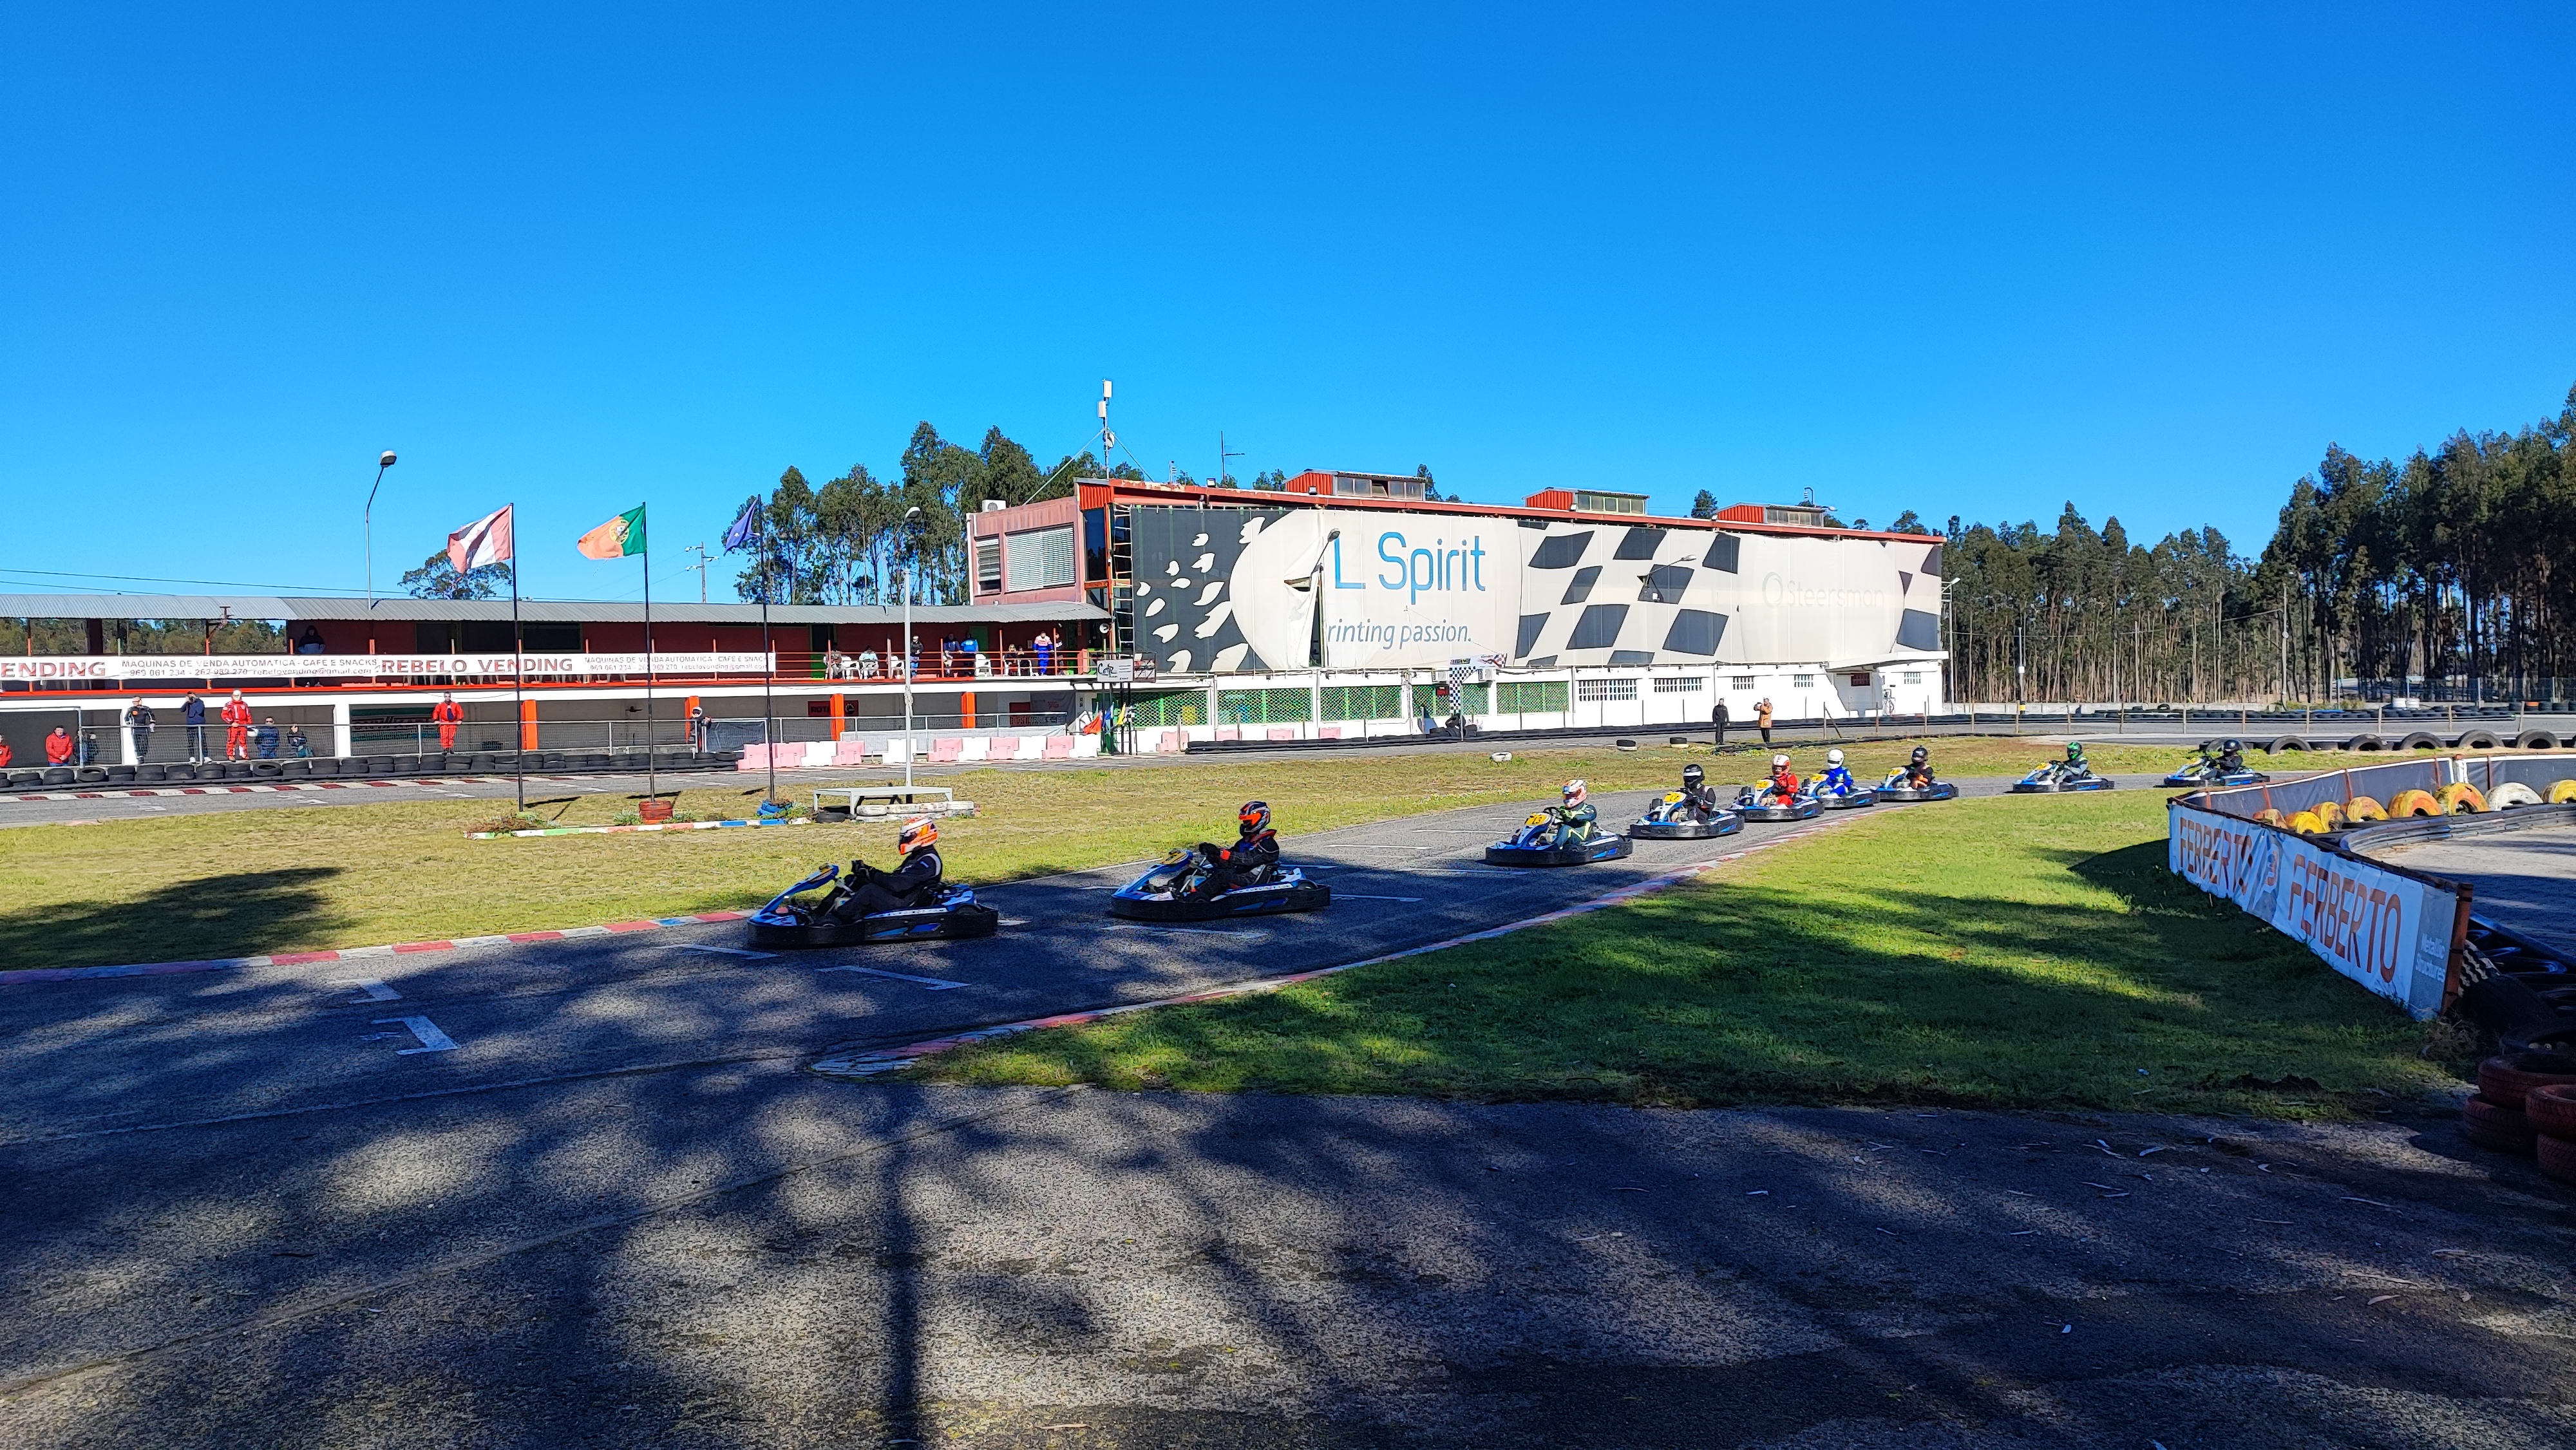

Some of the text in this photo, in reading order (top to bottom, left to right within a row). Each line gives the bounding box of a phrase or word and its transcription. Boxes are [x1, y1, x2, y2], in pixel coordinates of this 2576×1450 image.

[1378, 532, 1486, 605] Spirit
[1399, 619, 1472, 650] passion.
[381, 658, 573, 673] REBELO VENDING
[2287, 854, 2401, 983] FERBERTO
